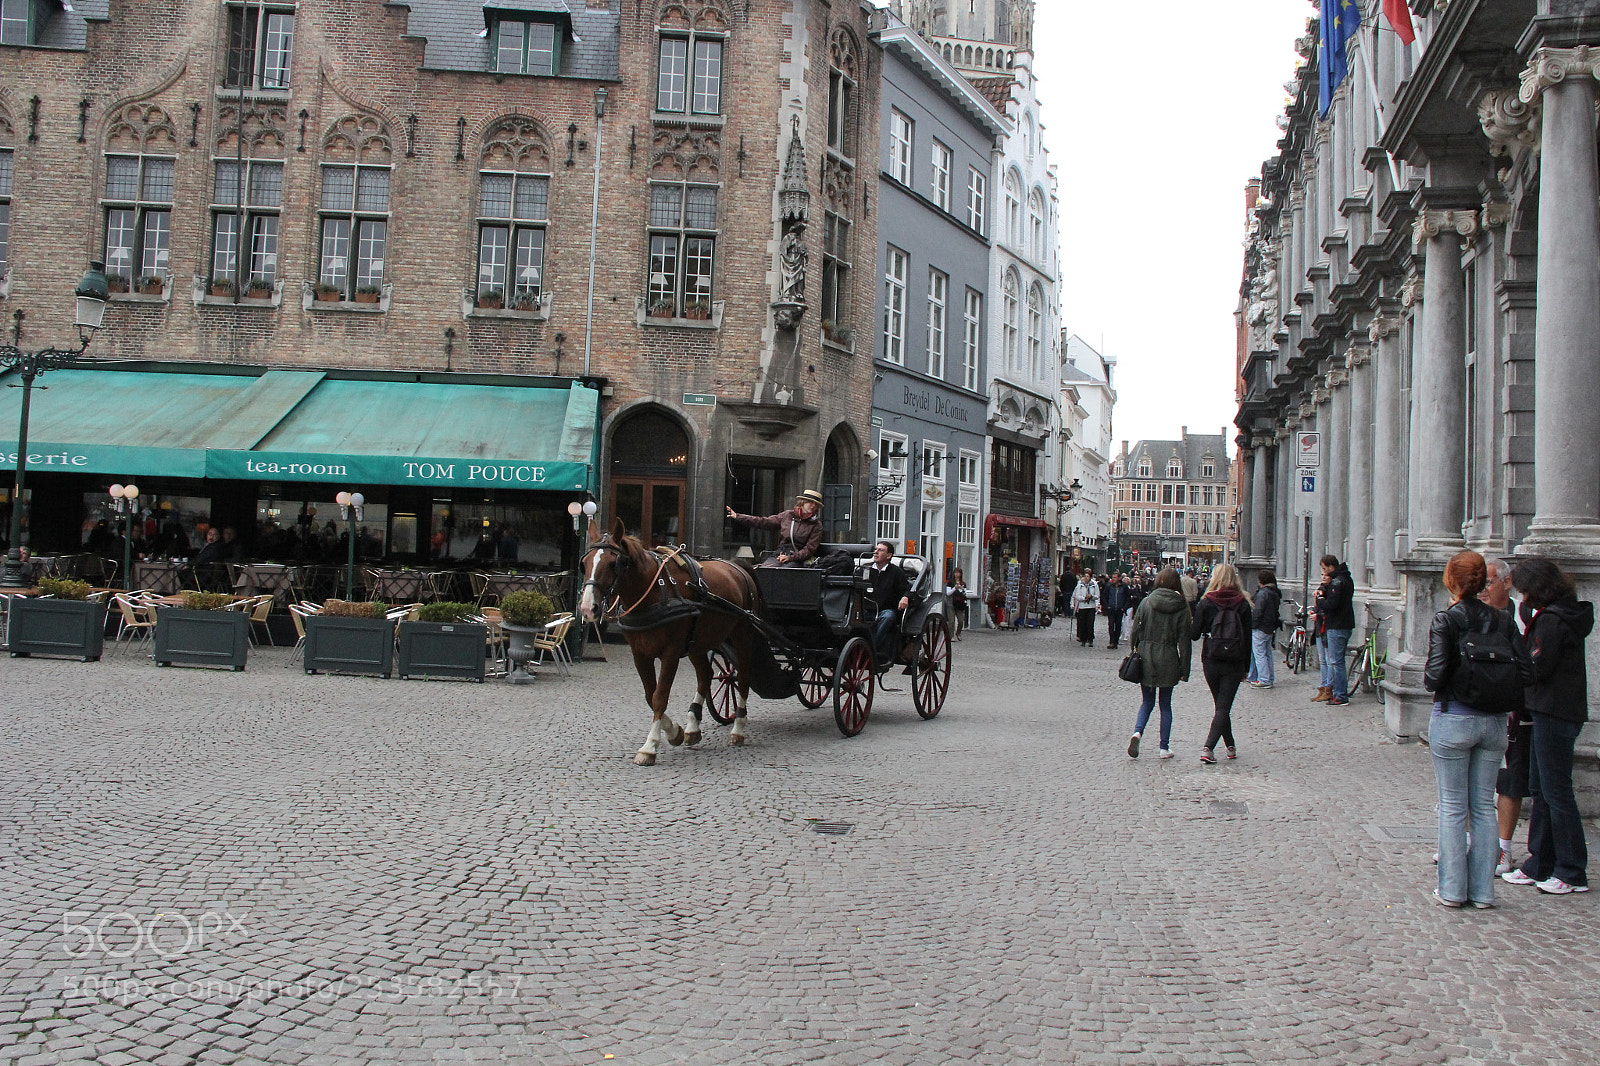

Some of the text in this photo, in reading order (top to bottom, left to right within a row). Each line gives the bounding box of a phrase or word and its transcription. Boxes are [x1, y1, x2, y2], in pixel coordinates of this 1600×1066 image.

[903, 385, 930, 413] Breydel
[246, 458, 547, 483] tea-room TOM POUCE
